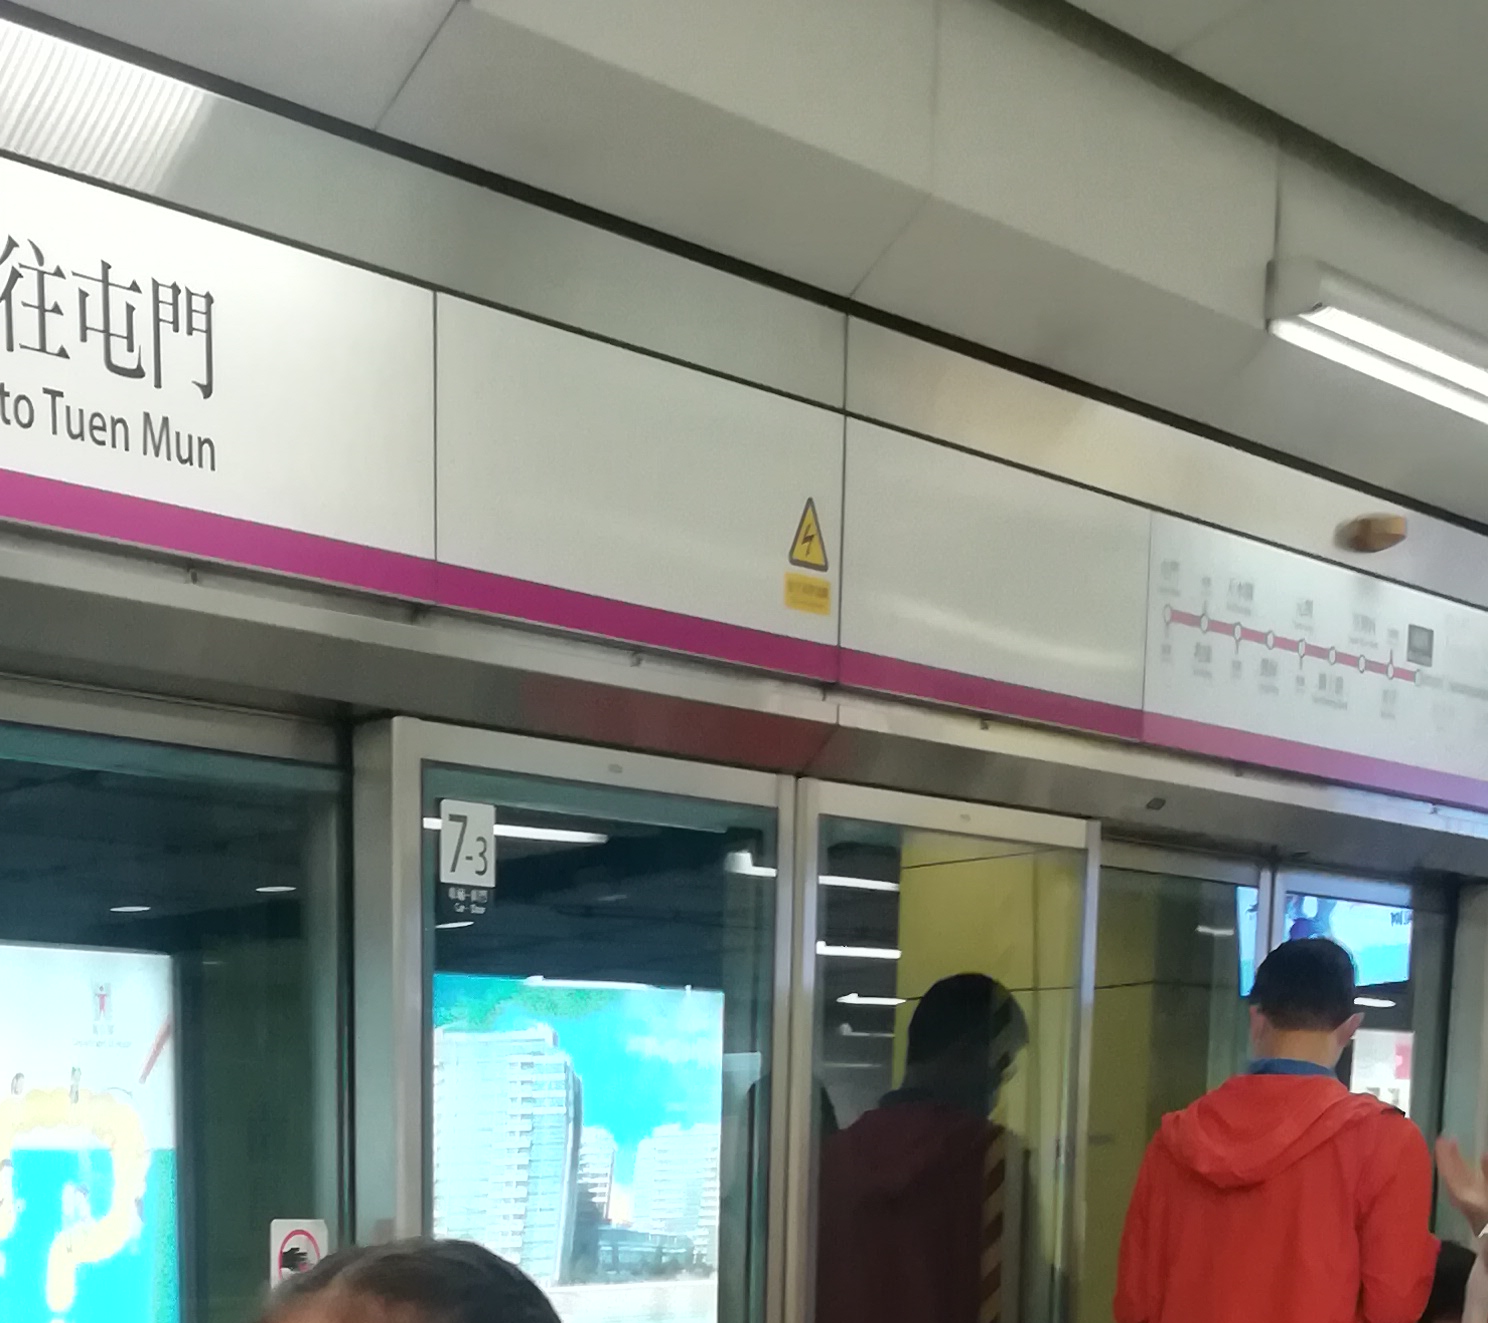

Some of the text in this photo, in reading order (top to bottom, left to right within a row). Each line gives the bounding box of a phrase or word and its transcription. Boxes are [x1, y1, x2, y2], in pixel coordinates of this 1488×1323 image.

[42, 386, 130, 452] Tuen
[142, 411, 217, 472] Mun
[448, 813, 488, 876] 7-3
